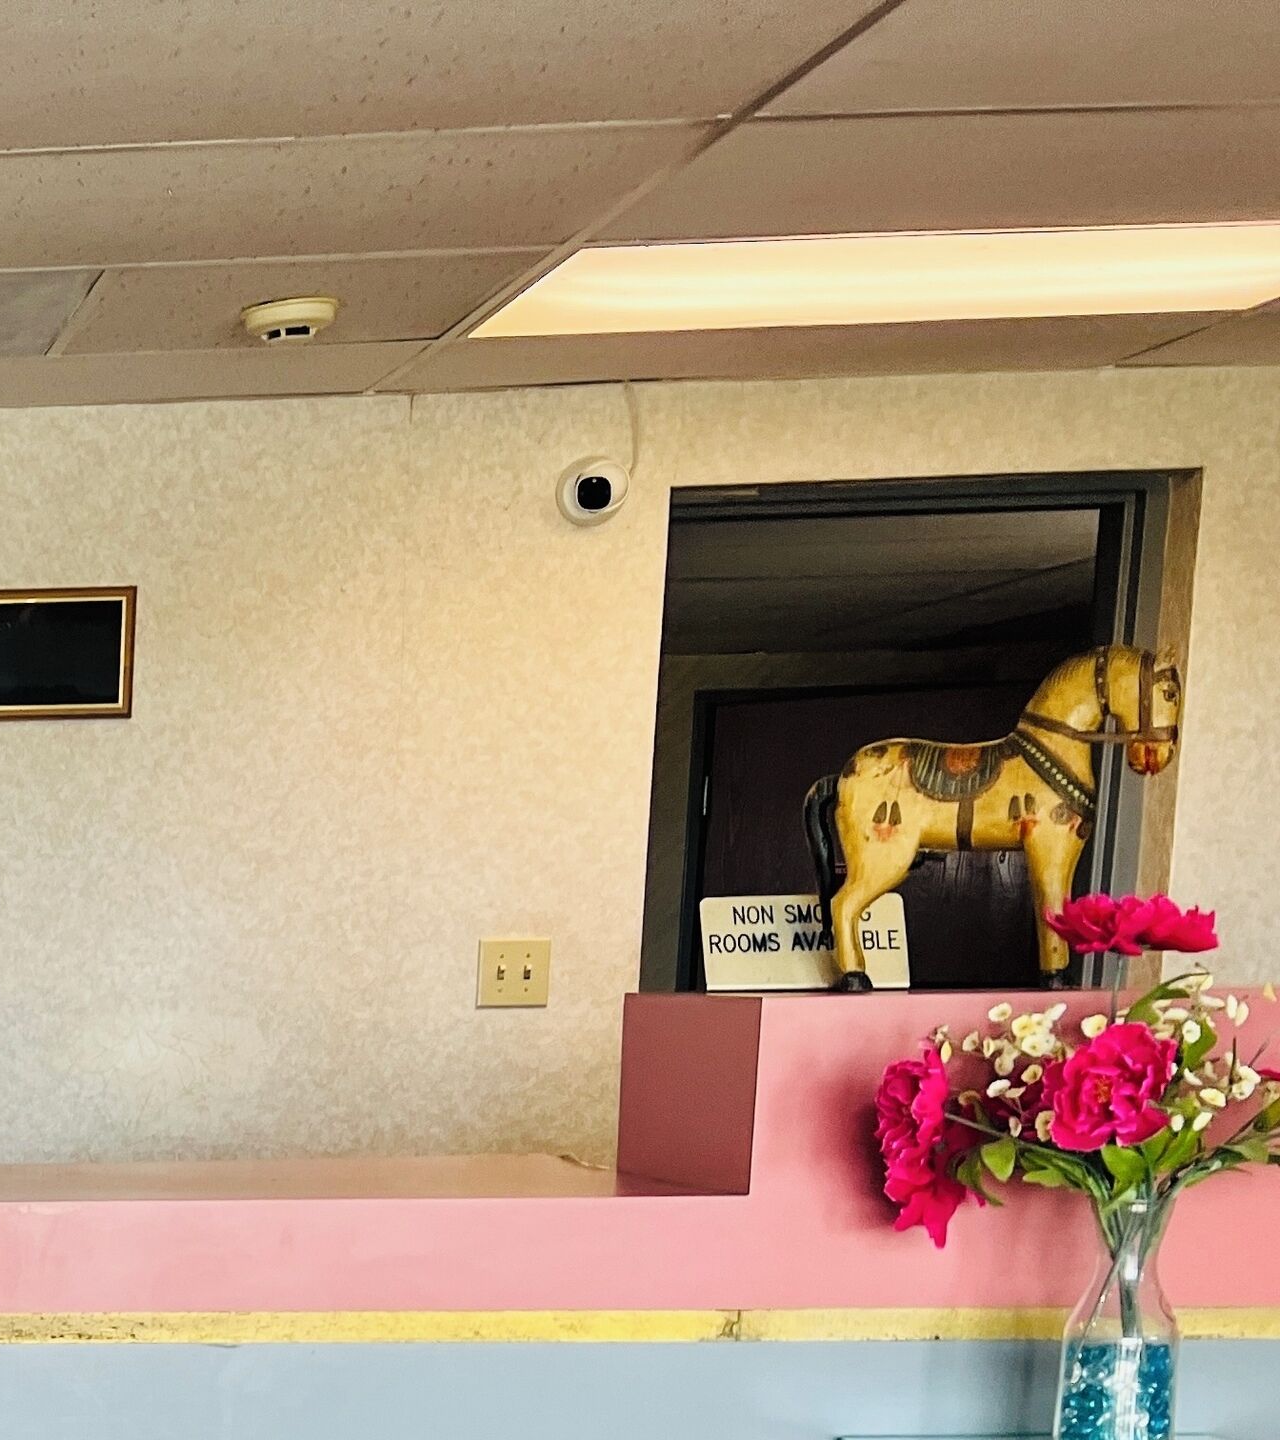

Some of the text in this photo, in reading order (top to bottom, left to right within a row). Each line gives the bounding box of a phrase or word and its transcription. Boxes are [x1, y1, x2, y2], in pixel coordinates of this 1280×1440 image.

[732, 904, 872, 925] NON SMOG
[709, 929, 901, 954] ROOMS AVAIBLE
